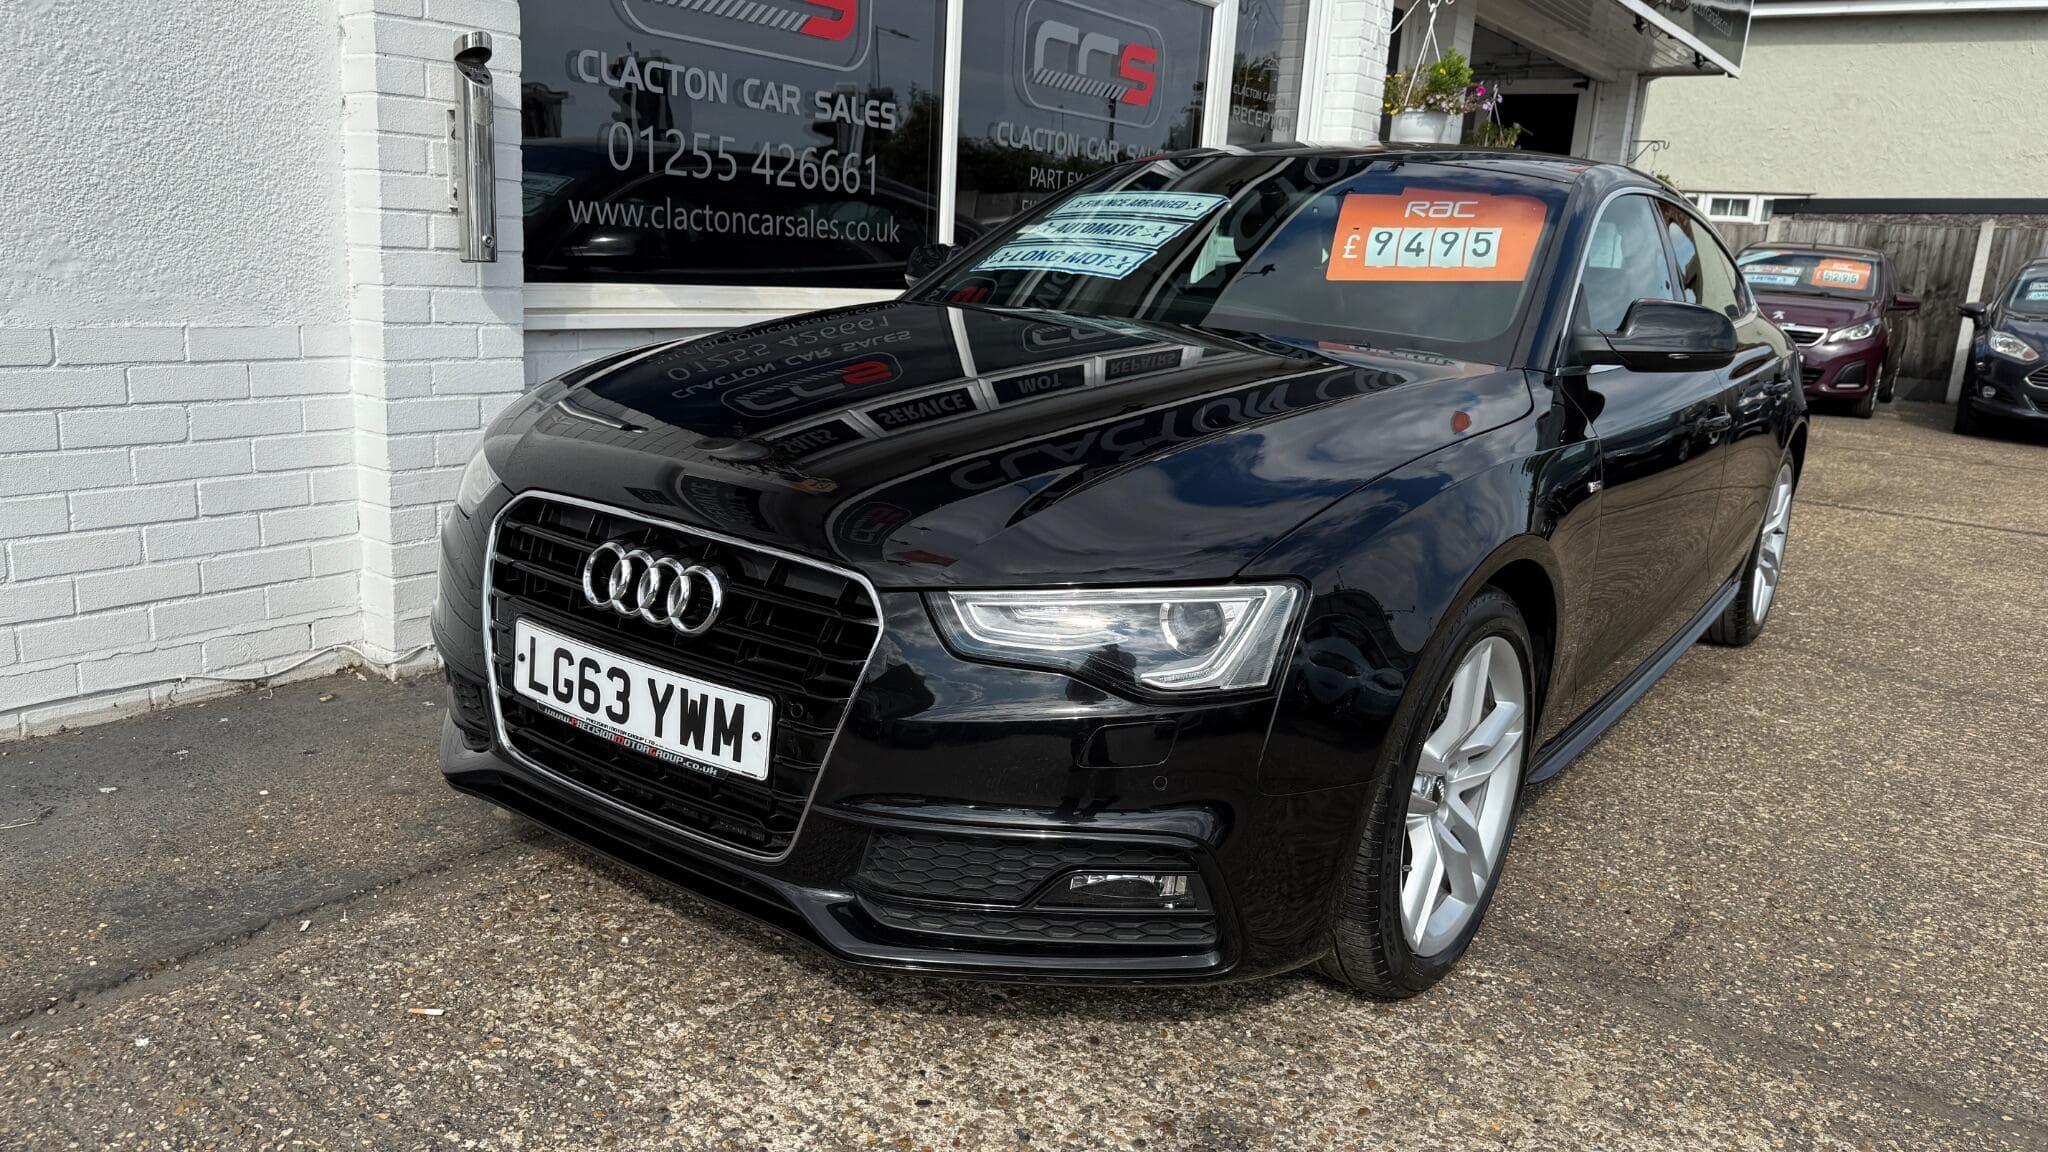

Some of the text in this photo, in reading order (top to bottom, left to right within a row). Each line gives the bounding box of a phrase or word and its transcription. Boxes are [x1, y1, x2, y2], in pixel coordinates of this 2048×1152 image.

[577, 49, 897, 131] CLACTON CAR SALES
[607, 121, 878, 196] 01255 426661
[996, 121, 1080, 158] CLACTON
[1087, 136, 1119, 164] CAR
[1029, 166, 1064, 190] PART
[568, 197, 901, 243] www.clactoncarsales.co.uk
[1055, 222, 1145, 236] AUTOMATIC
[1010, 249, 1116, 266] LONG MOT
[1342, 231, 1494, 259] £ 9495
[1824, 272, 1857, 283] 5295
[528, 636, 746, 763] LG63 YWM
